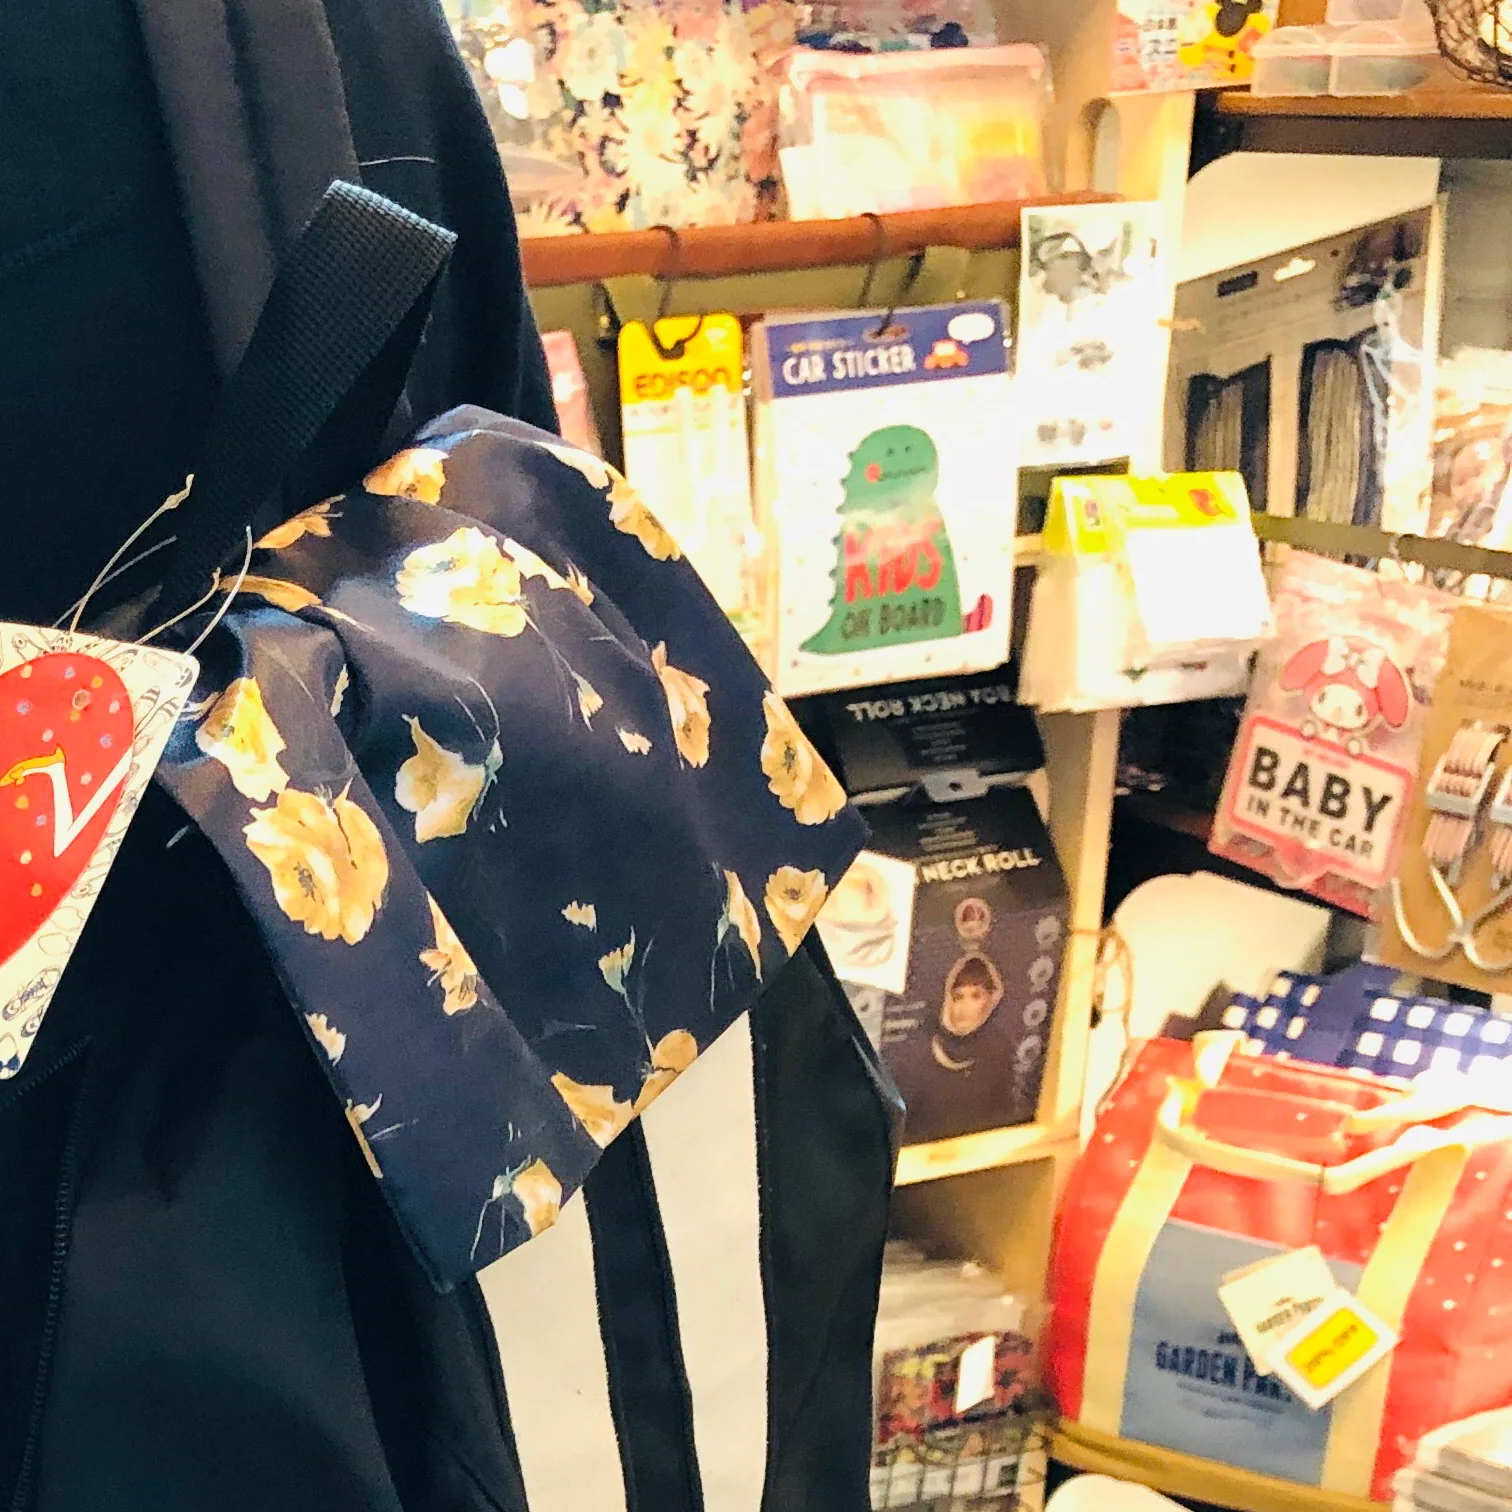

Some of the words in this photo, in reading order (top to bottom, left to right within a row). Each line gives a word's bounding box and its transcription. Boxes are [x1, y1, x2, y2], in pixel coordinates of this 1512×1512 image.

[782, 353, 827, 385] CAR
[832, 343, 917, 380] STICKER
[844, 519, 944, 605] KIDS
[845, 699, 905, 723] ROLL
[908, 691, 966, 714] NECK
[1248, 745, 1392, 833] BABY
[1246, 795, 1270, 819] IN
[1279, 806, 1322, 839] THE
[1329, 827, 1374, 858] CAR
[921, 857, 983, 884] NECK
[984, 848, 1043, 873] ROLL
[1155, 1339, 1238, 1388] GARDEN
